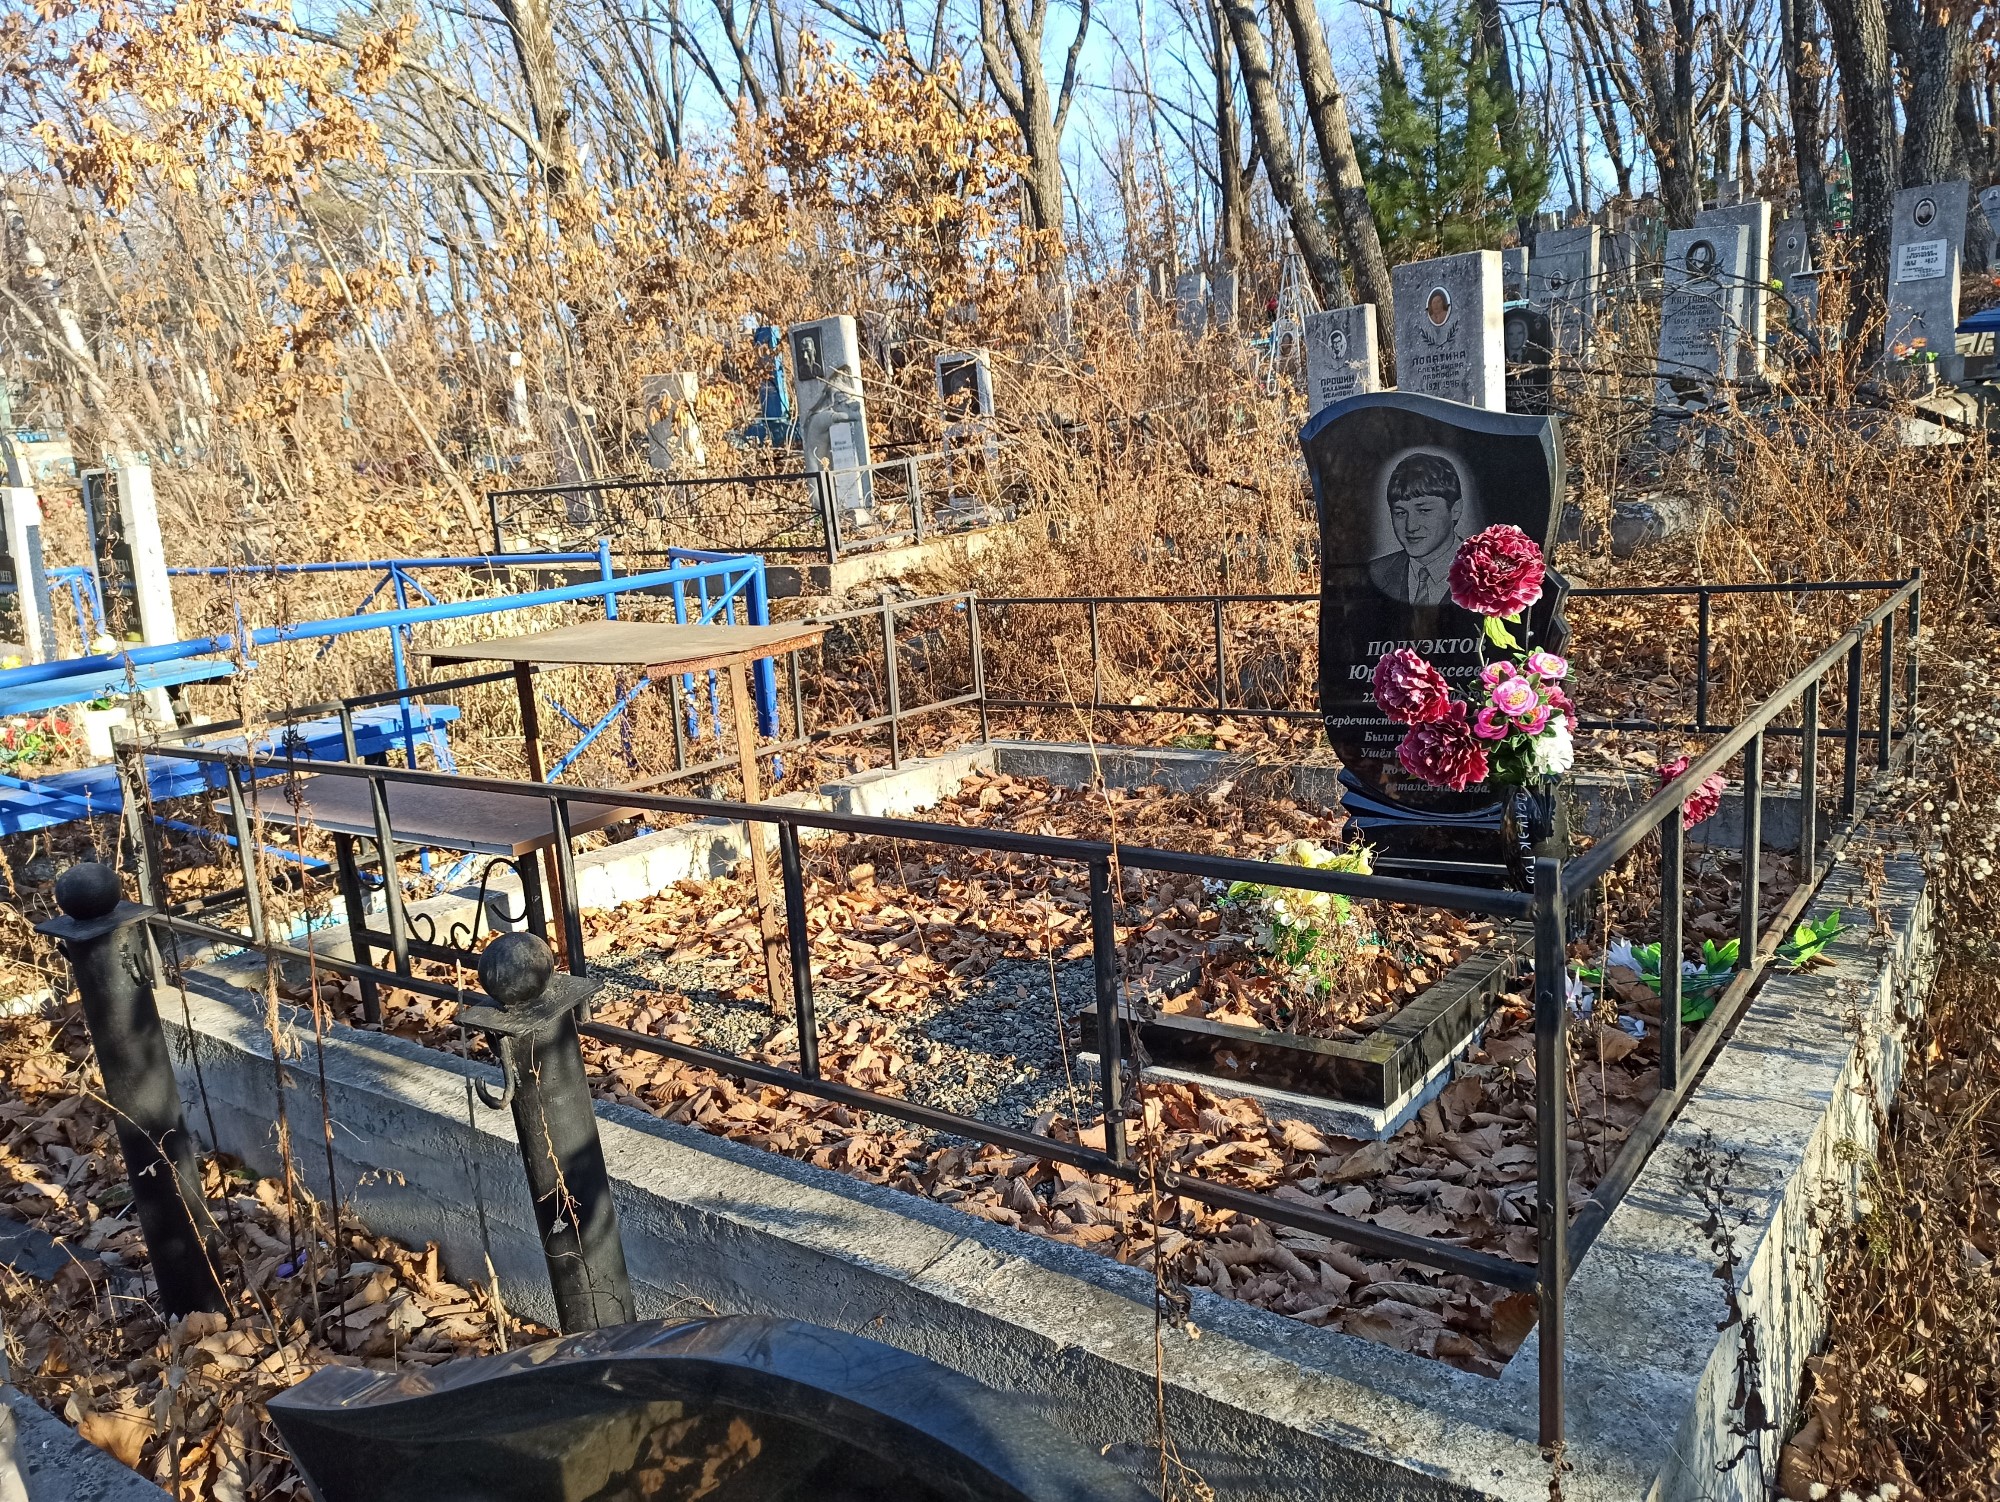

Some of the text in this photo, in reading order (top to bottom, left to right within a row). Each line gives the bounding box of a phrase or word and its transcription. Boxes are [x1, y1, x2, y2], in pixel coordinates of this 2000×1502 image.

[1412, 351, 1466, 367] ЛОПАТИНА
[1320, 374, 1355, 387] ПРОШИН
[1364, 731, 1395, 742] Была
[1360, 747, 1392, 758] Ушёл
